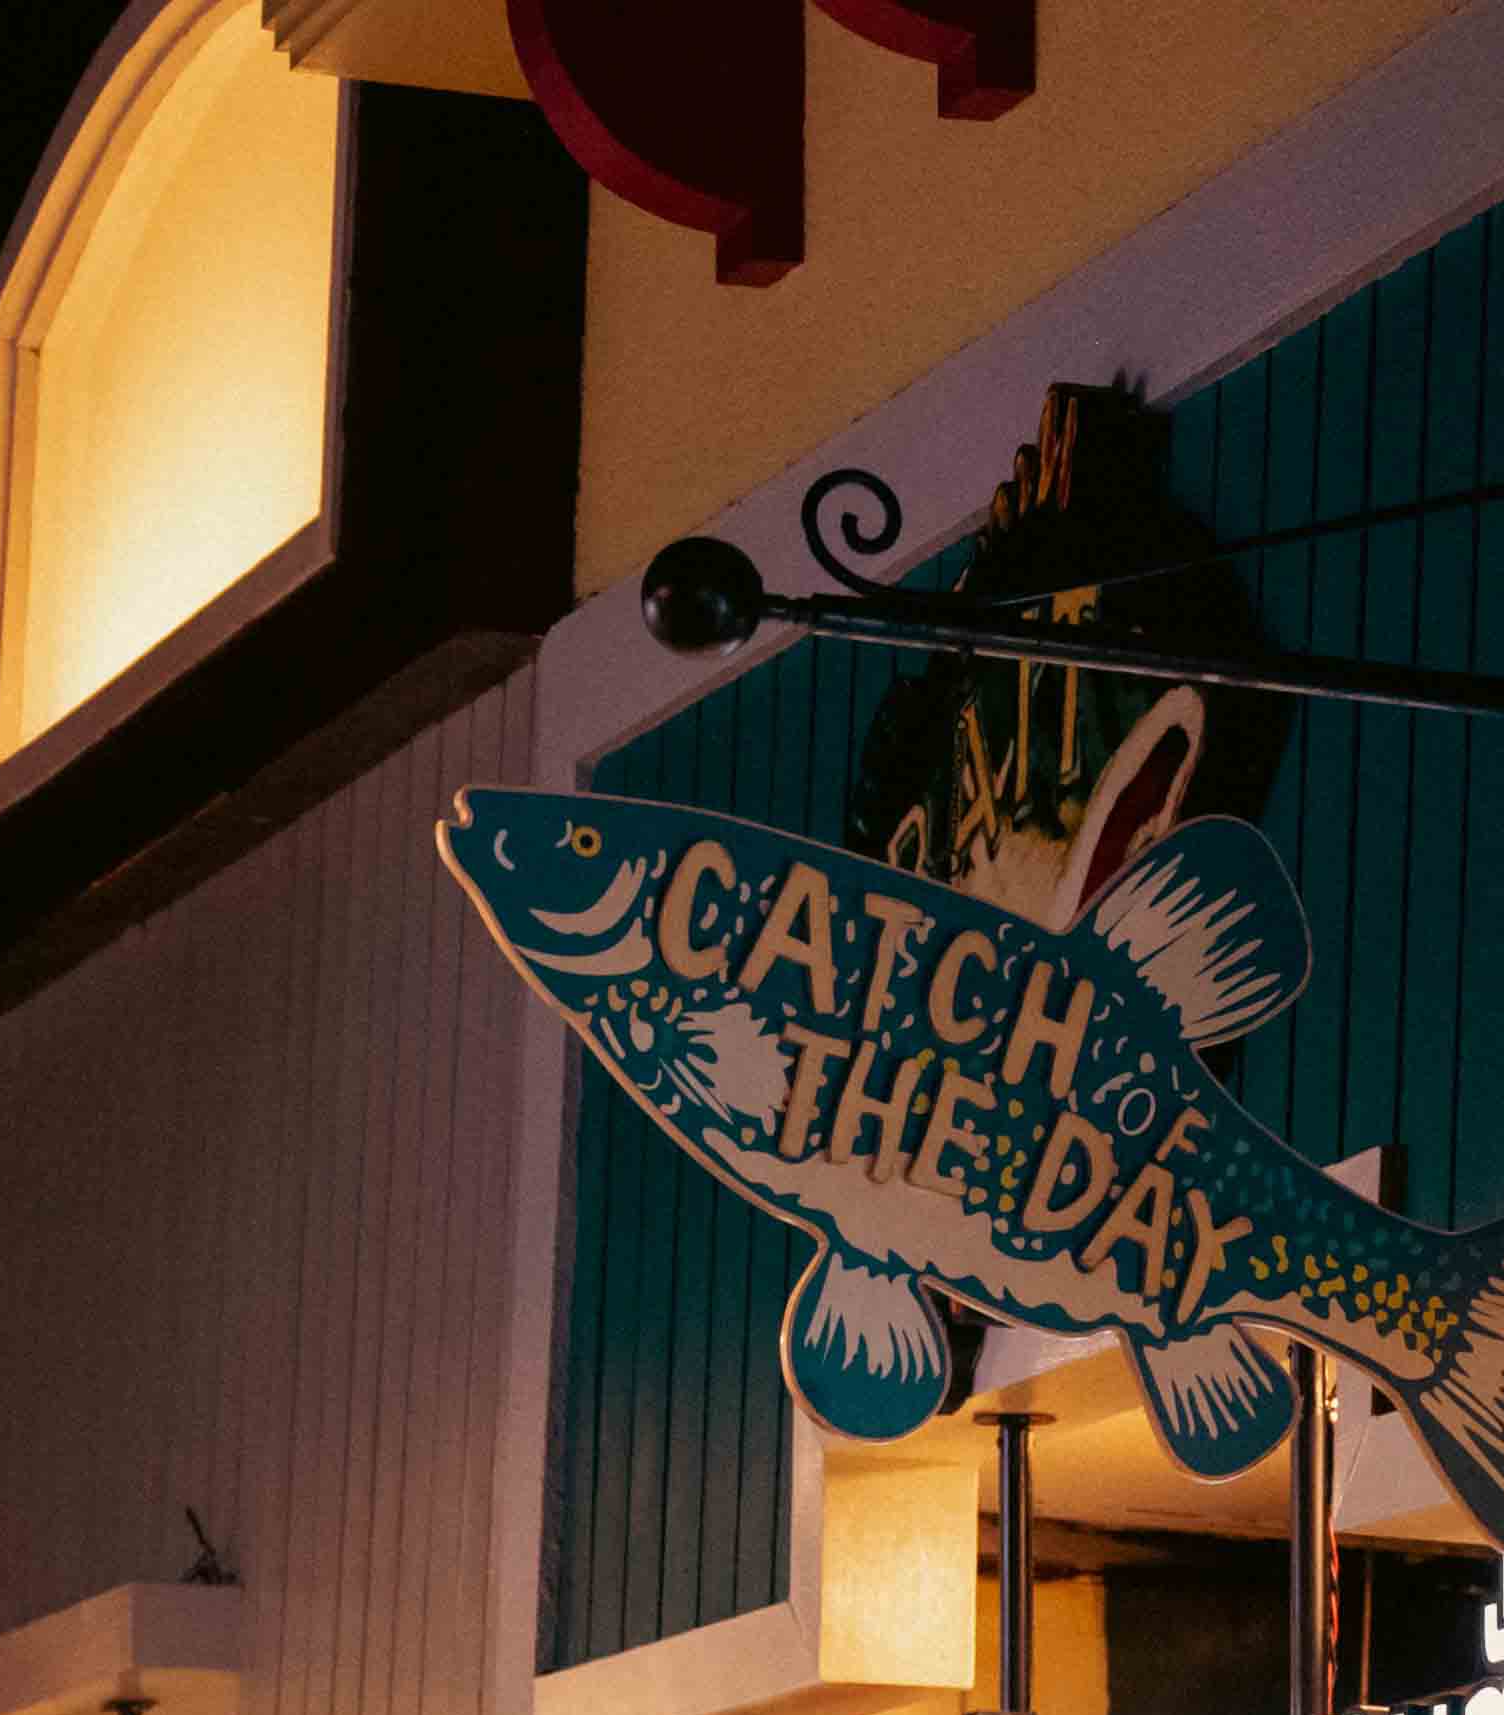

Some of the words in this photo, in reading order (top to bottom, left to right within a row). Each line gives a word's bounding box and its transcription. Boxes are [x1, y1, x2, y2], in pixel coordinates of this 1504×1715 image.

[656, 840, 1095, 1097] CATCH
[779, 1023, 1001, 1198] THE
[1021, 1112, 1253, 1324] DAY
